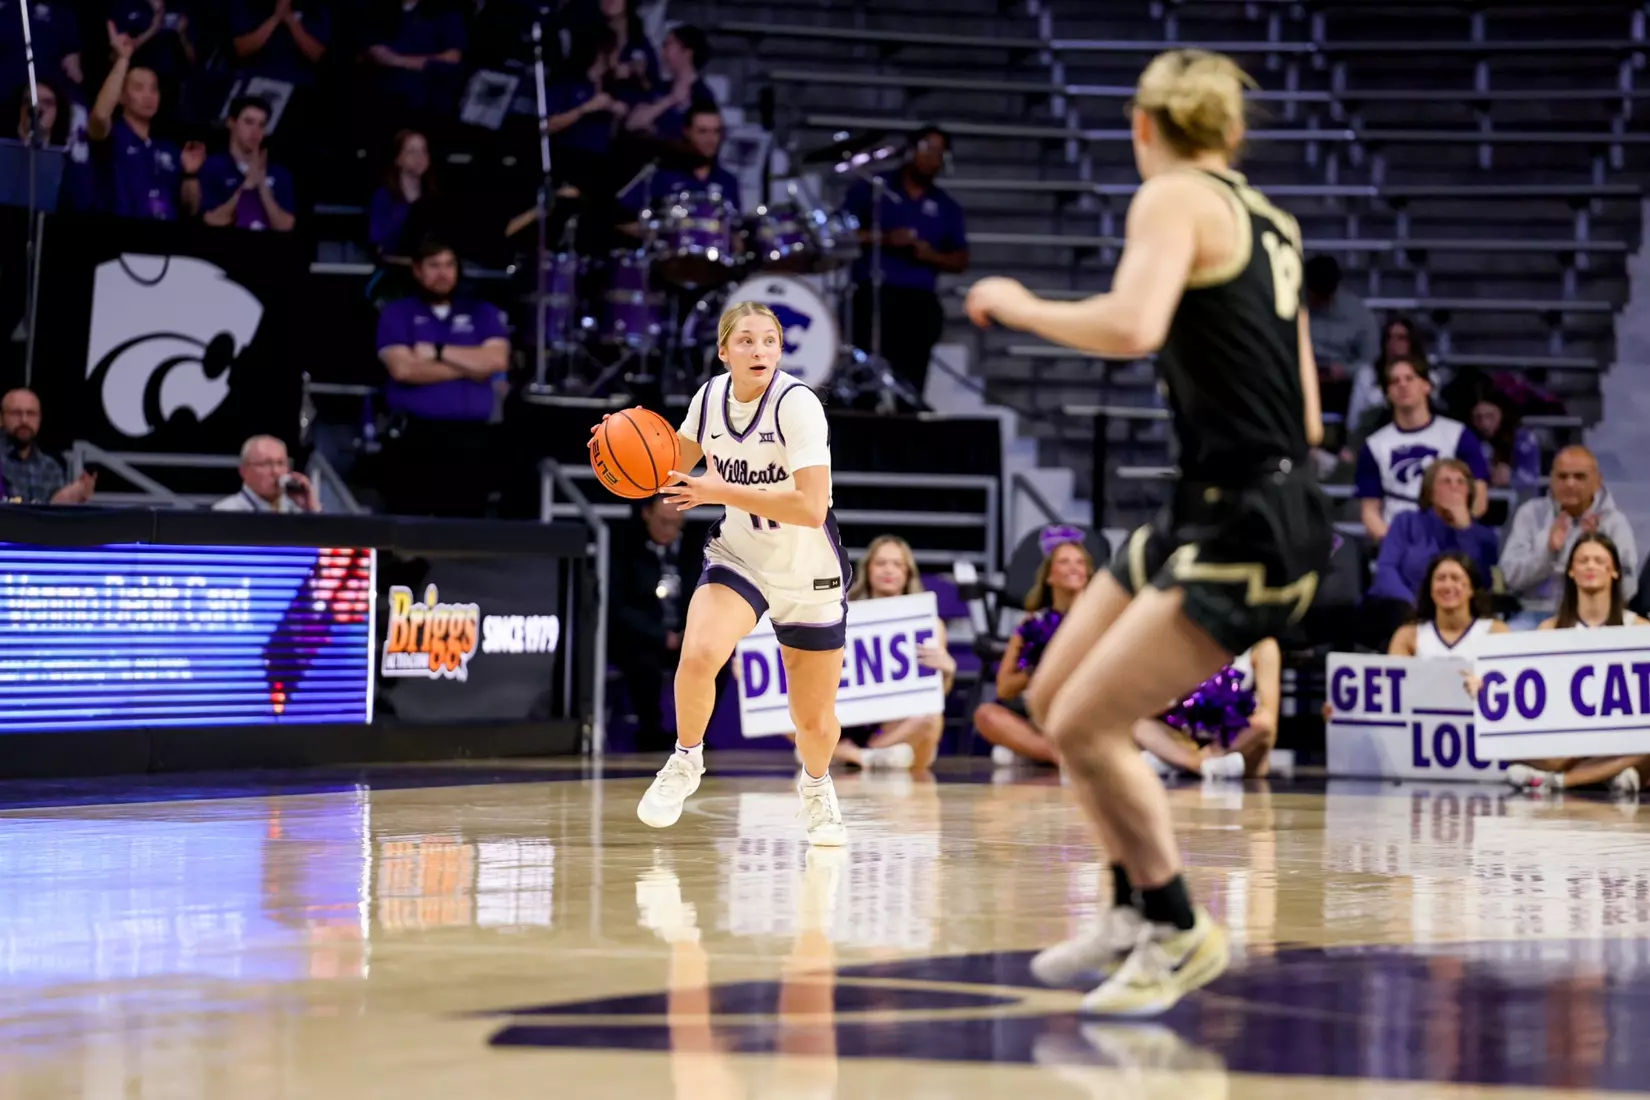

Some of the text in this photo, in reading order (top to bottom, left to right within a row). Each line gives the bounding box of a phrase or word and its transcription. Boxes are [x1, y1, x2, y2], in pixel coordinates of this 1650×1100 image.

[592, 438, 618, 486] ELITE
[712, 454, 790, 486] Wildcats
[387, 588, 477, 673] Briggs
[1331, 666, 1406, 713] GET
[1478, 668, 1546, 721] GO
[1412, 721, 1508, 771] LOU
